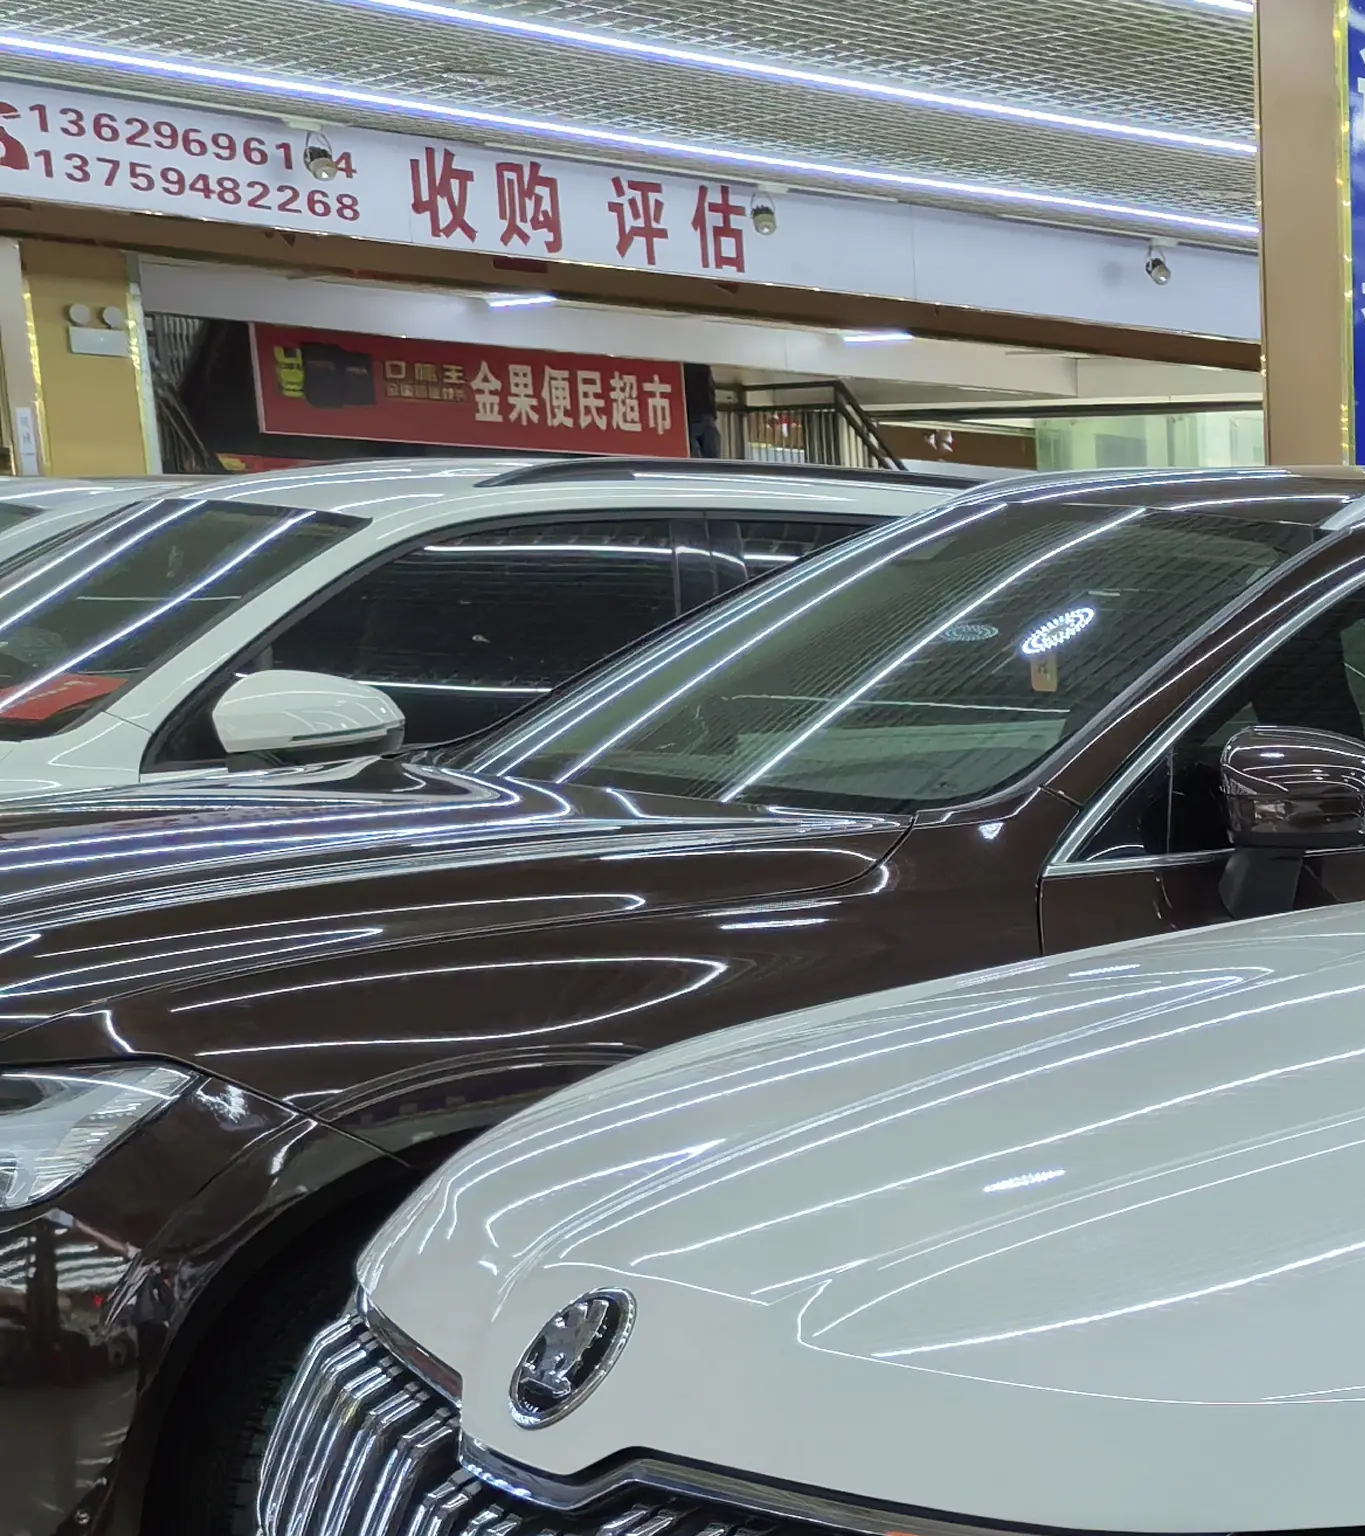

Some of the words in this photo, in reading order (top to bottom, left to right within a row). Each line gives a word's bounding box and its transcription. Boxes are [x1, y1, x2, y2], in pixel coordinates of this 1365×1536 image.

[29, 104, 357, 178] 1362969614
[34, 149, 361, 221] 13759482268
[409, 147, 563, 253] 收购
[608, 176, 746, 273] 评估
[470, 360, 672, 435] 金果便民超市
